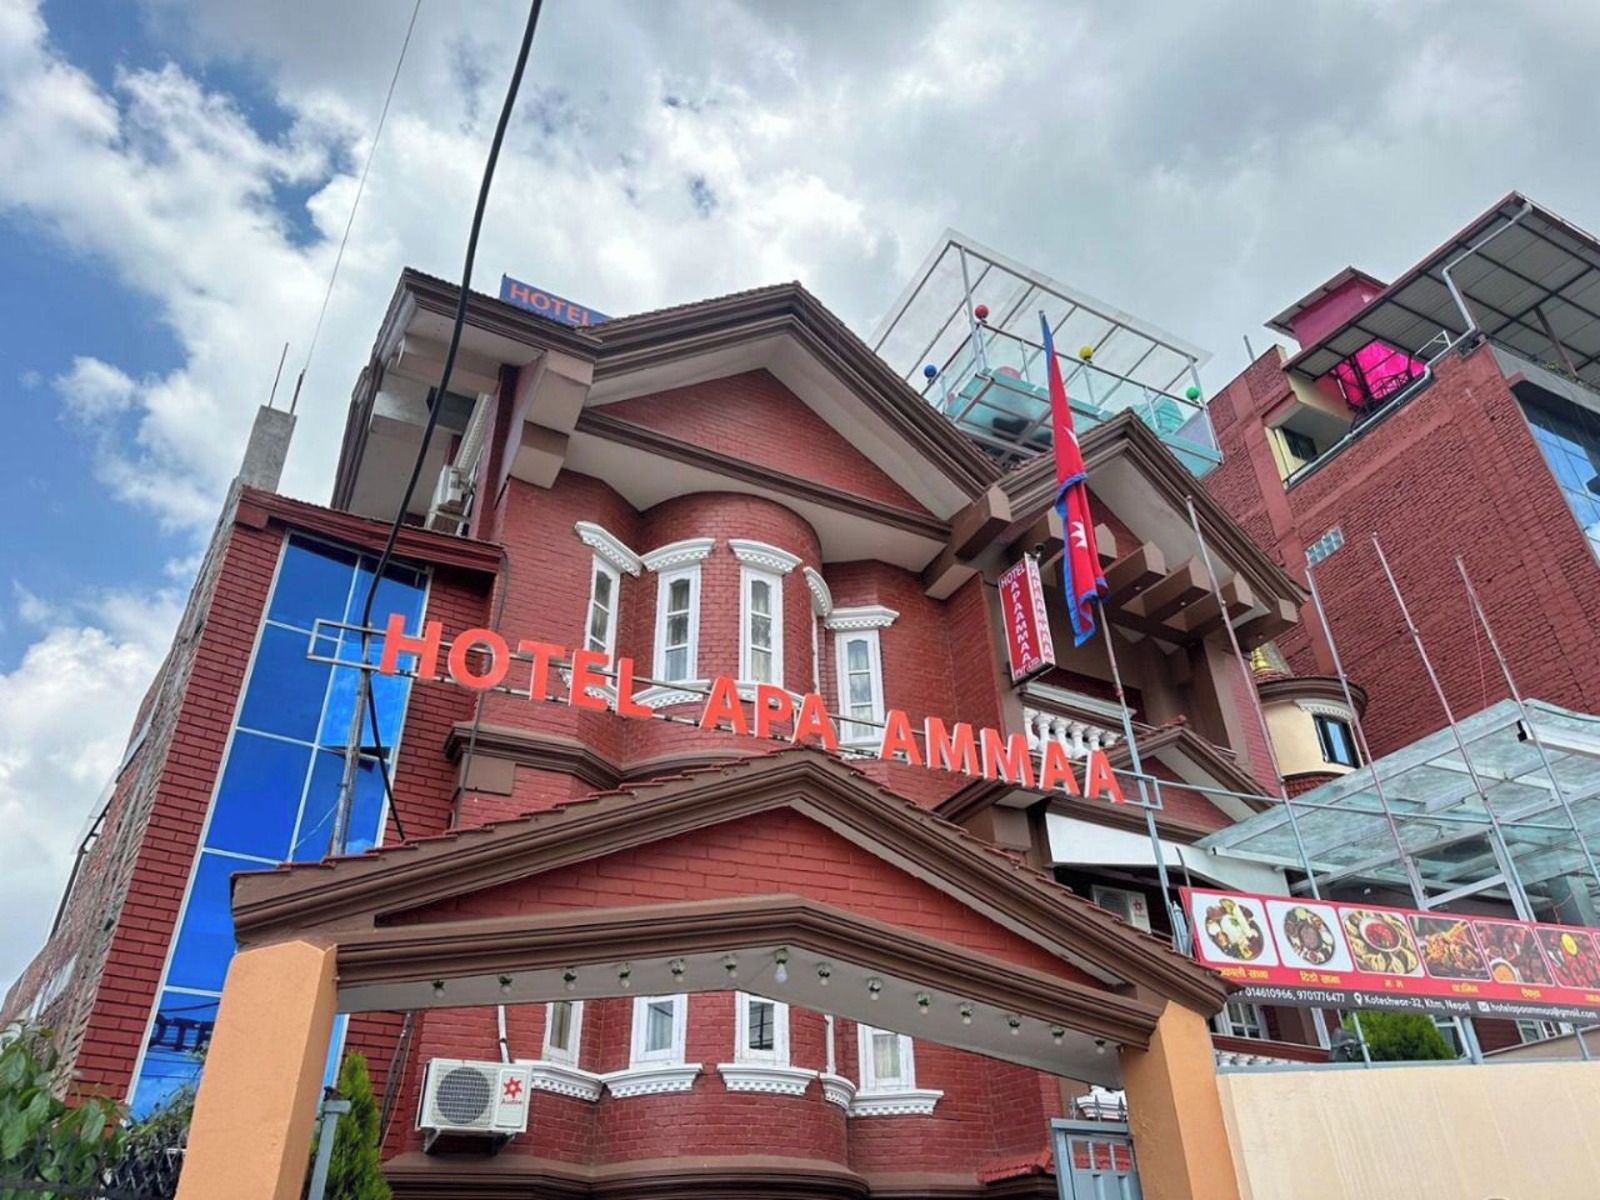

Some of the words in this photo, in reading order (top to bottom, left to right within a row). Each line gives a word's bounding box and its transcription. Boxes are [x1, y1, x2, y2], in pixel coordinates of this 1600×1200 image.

[509, 282, 593, 328] HOTEL
[1000, 562, 1026, 588] HOTEL
[379, 612, 653, 718] HOTEL
[699, 675, 838, 752] APA
[878, 708, 1127, 805] AMMAA
